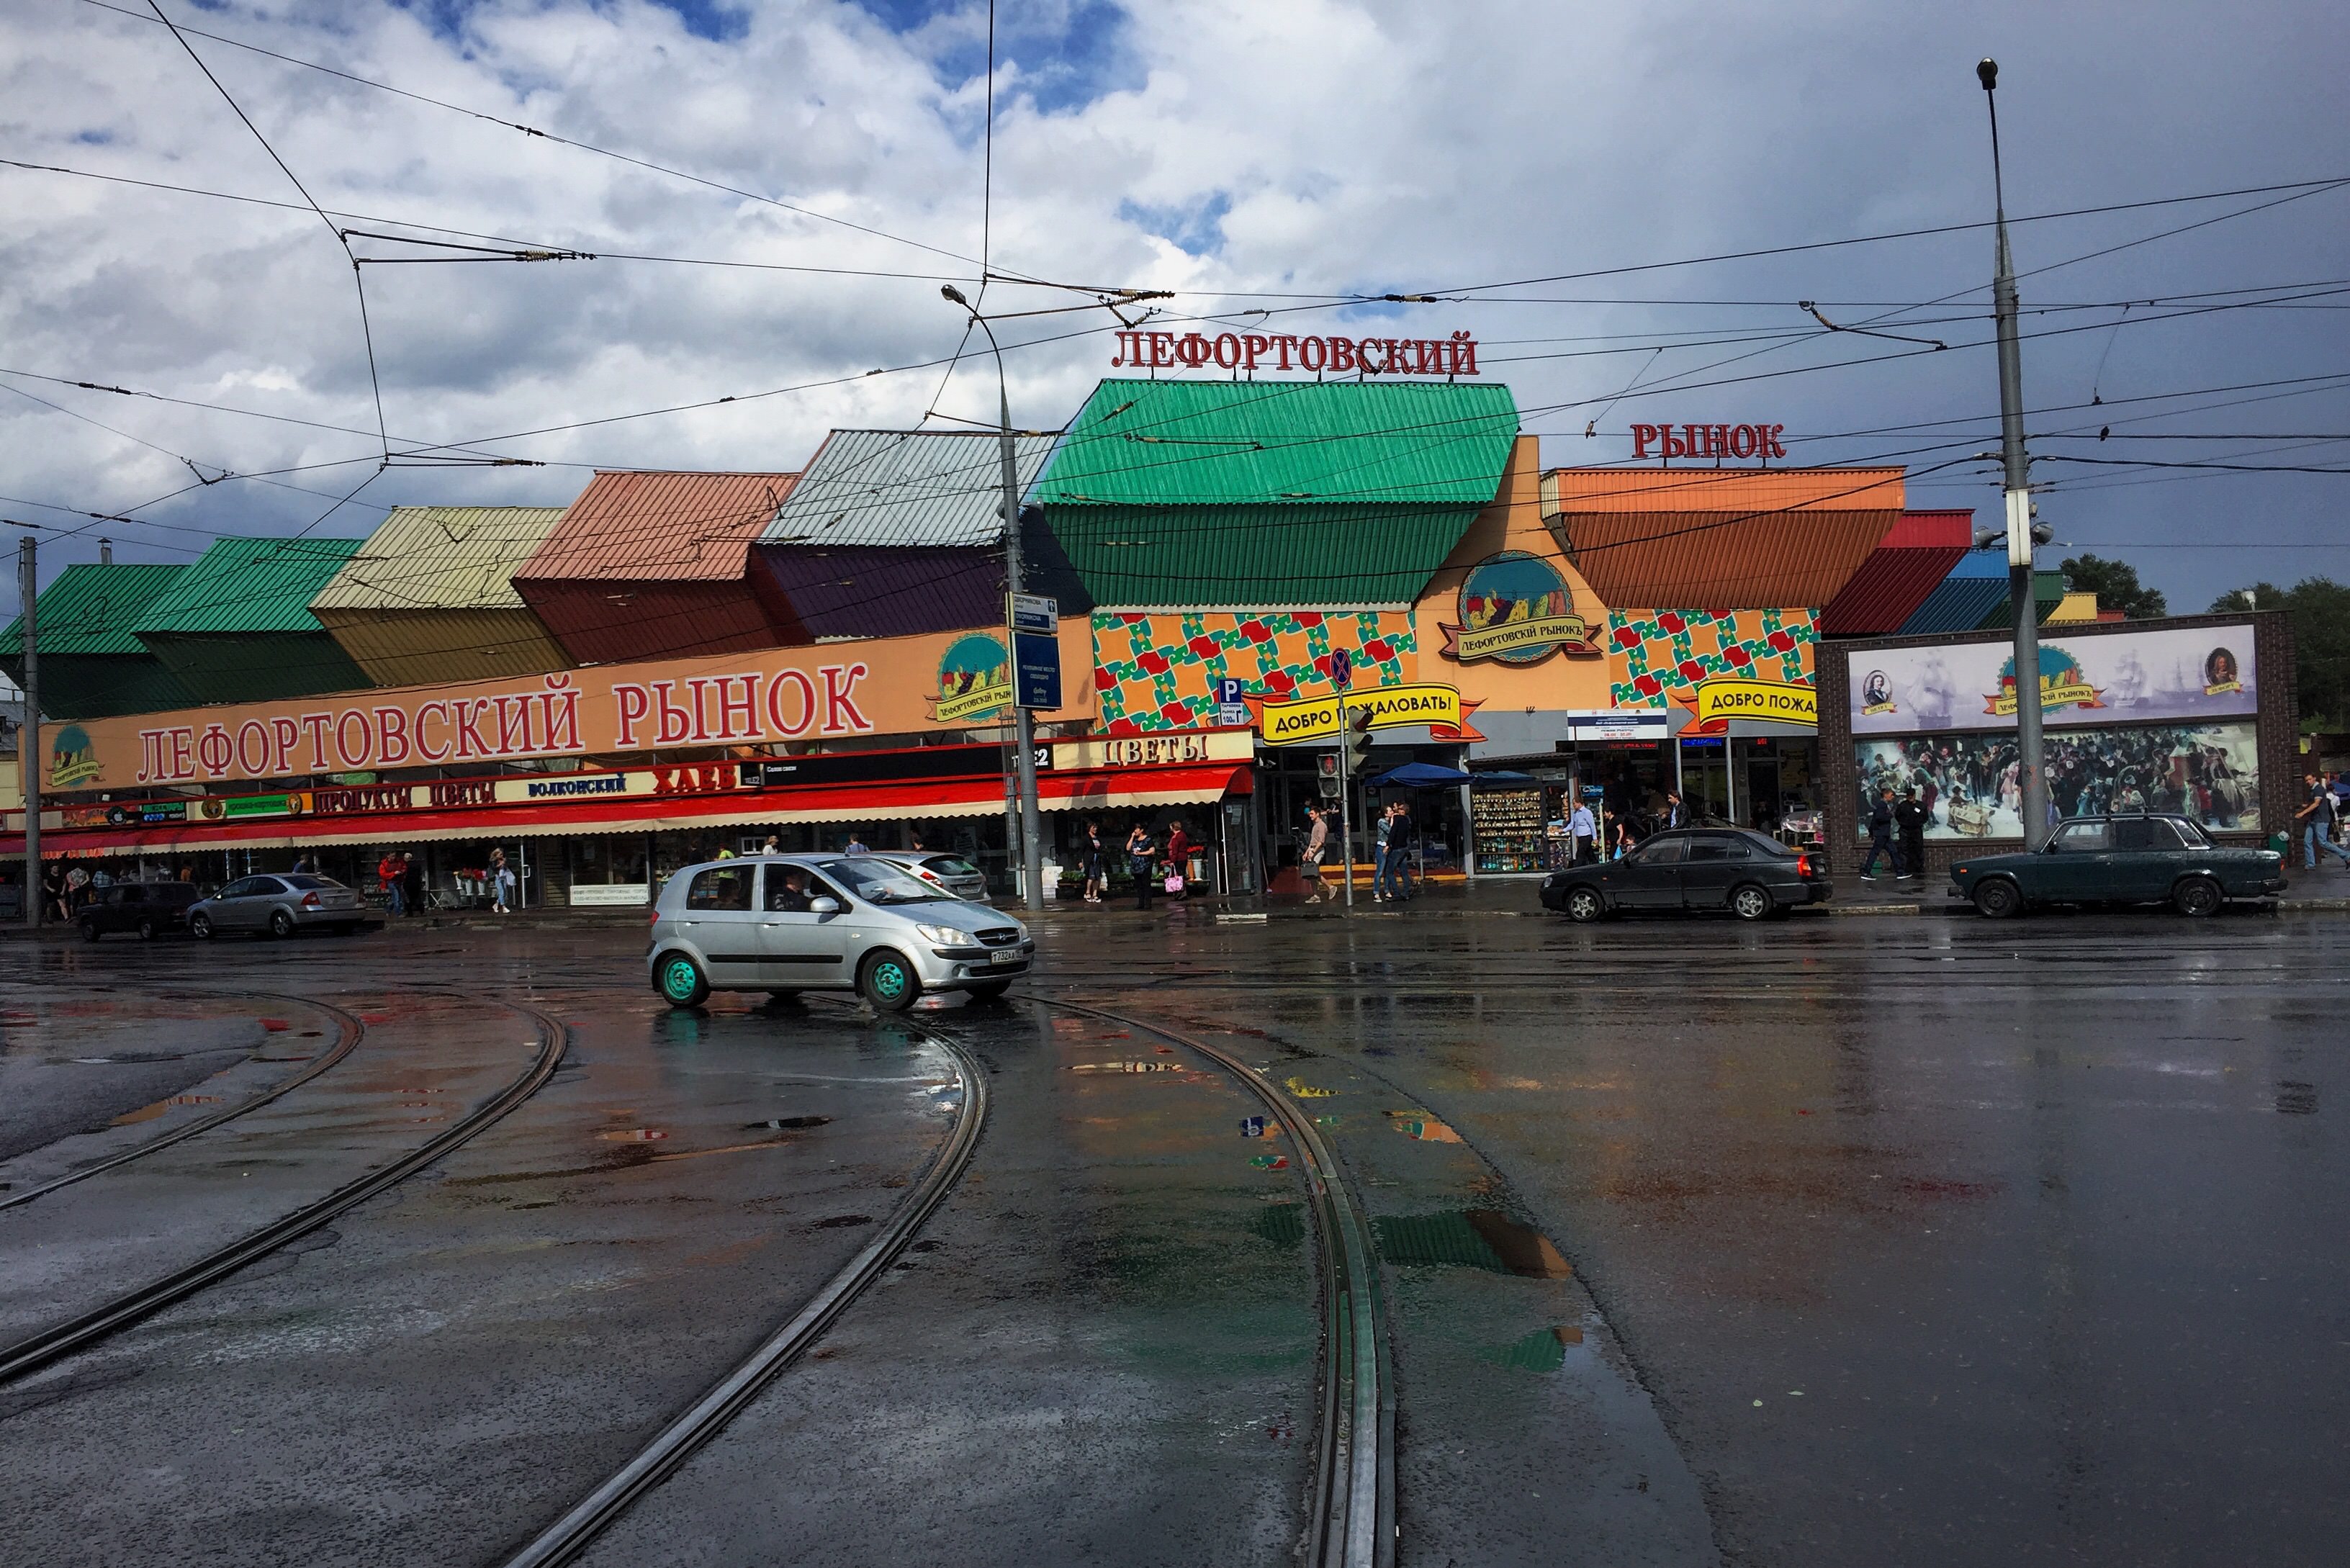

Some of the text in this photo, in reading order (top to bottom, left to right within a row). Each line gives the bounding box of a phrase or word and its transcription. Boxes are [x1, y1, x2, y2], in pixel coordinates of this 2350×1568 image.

[1112, 330, 1480, 376] ЛЕФОРТОВСКИЙ
[1630, 423, 1787, 459] РЫНОК
[1540, 625, 1583, 638] РЫНОКЪ
[1225, 680, 1238, 702] P
[1711, 693, 1817, 714] ДОБРО ПОЖА
[136, 662, 874, 785] ЛЕФОРТОВСКИЙ РЫНОК
[1275, 710, 1332, 734] ДОБРО
[1102, 734, 1209, 767] ЦВЕТЫ
[653, 765, 737, 794] ХЛЕБ
[315, 782, 497, 812] ПРОДУКТЫ ЦВЕТЫ
